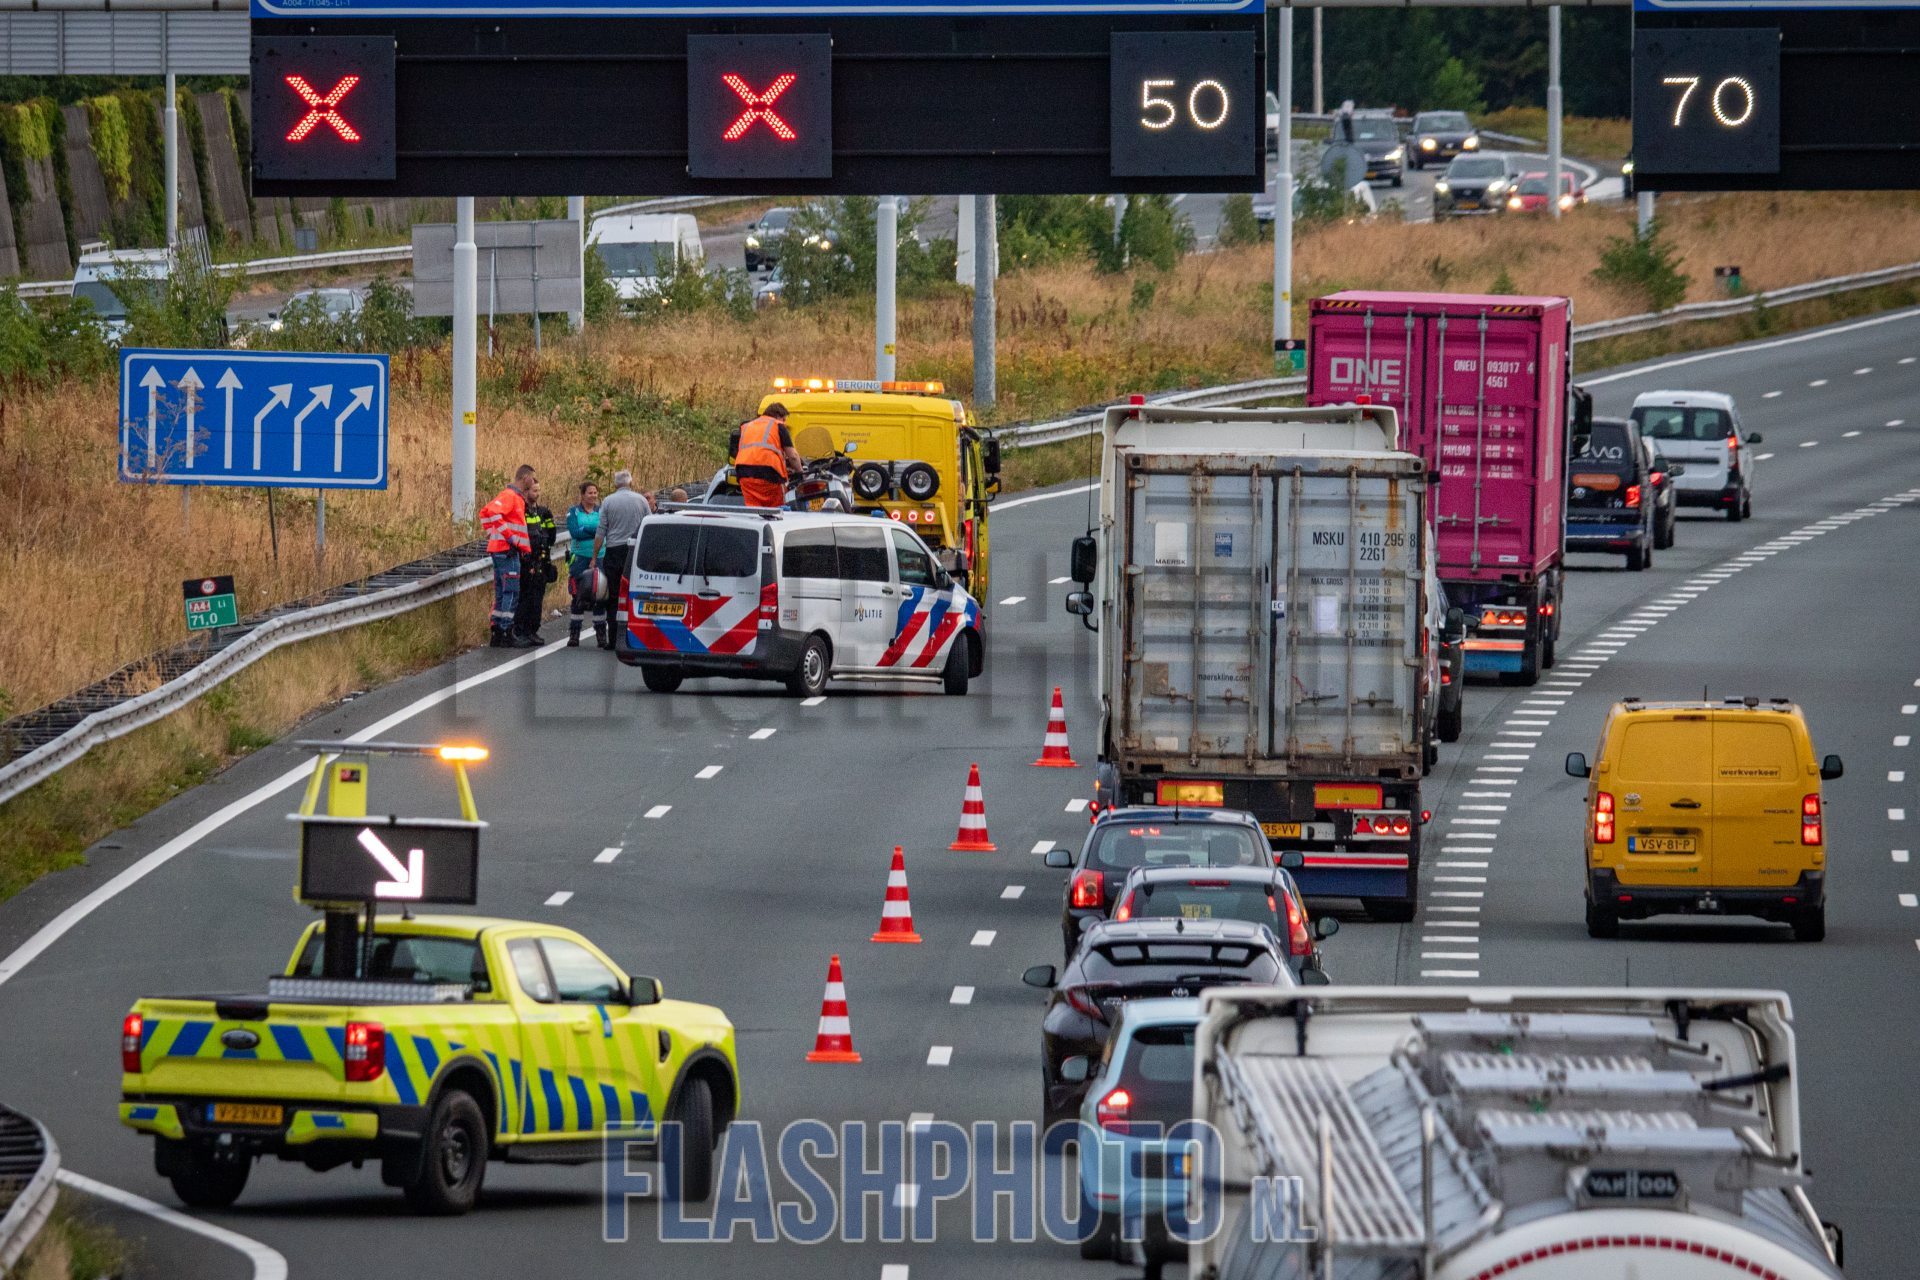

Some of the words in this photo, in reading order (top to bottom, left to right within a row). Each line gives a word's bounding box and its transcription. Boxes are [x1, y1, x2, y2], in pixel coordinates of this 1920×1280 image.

[1141, 80, 1229, 128] 50
[1663, 76, 1753, 126] 70
[1330, 357, 1401, 385] ONE
[1454, 360, 1476, 372] ONEU
[1487, 362, 1520, 373] 093017
[1527, 363, 1535, 374] 4
[1312, 532, 1345, 545] MSKU
[1360, 532, 1380, 546] 410
[1384, 533, 1405, 546] 295
[1409, 534, 1417, 548] 8
[1155, 557, 1187, 565] MAERSK
[1360, 547, 1386, 561] 22G1
[639, 574, 671, 582] POLITIE
[1720, 768, 1778, 777] werkverkeer
[1641, 839, 1691, 850] VSV-81-P
